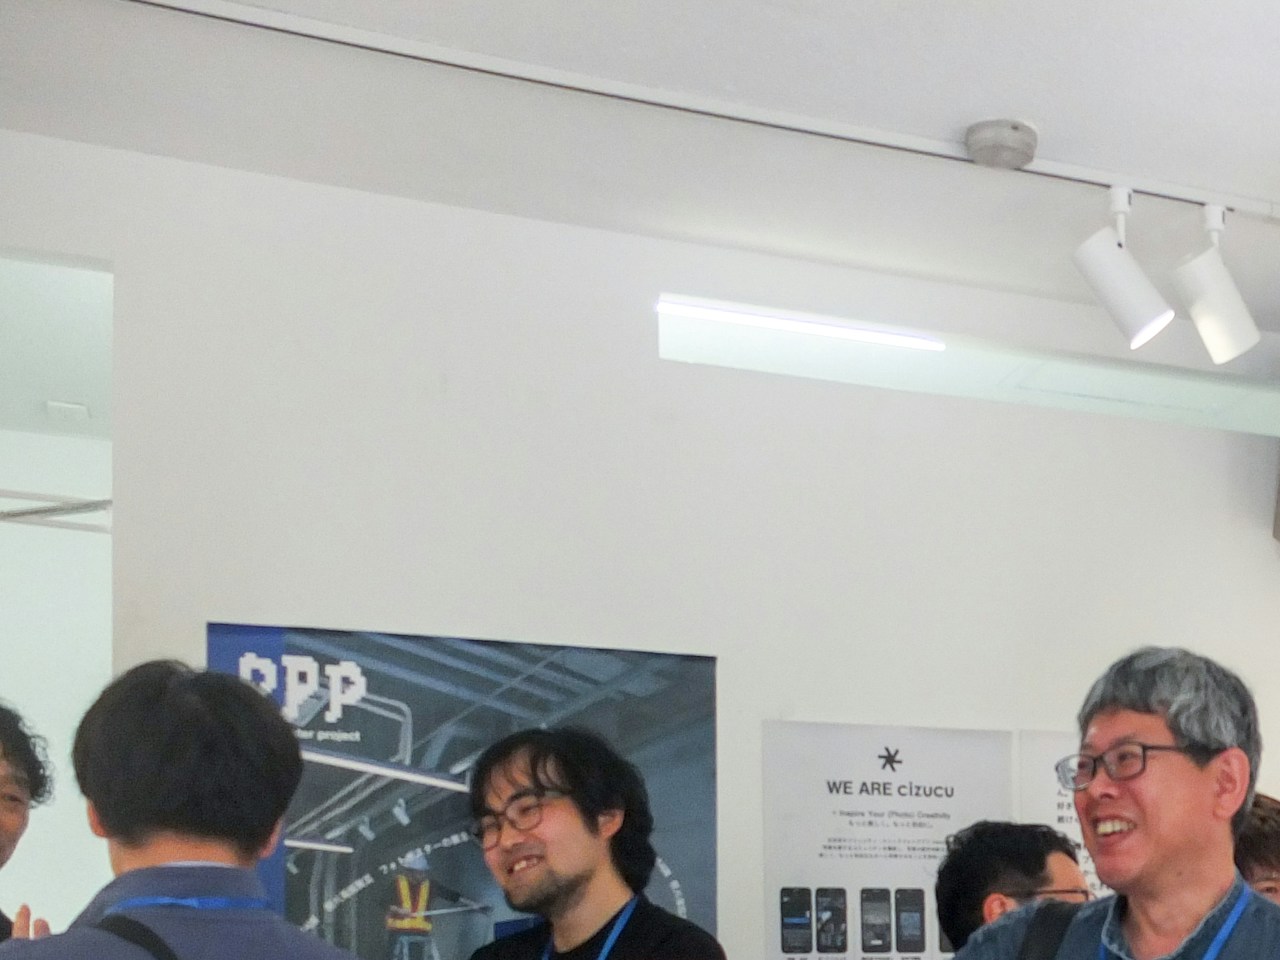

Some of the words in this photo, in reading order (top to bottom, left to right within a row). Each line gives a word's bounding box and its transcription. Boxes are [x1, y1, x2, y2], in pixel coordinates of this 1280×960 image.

[826, 781, 854, 795] WE
[859, 781, 893, 796] ARE
[897, 782, 955, 798] cizucu
